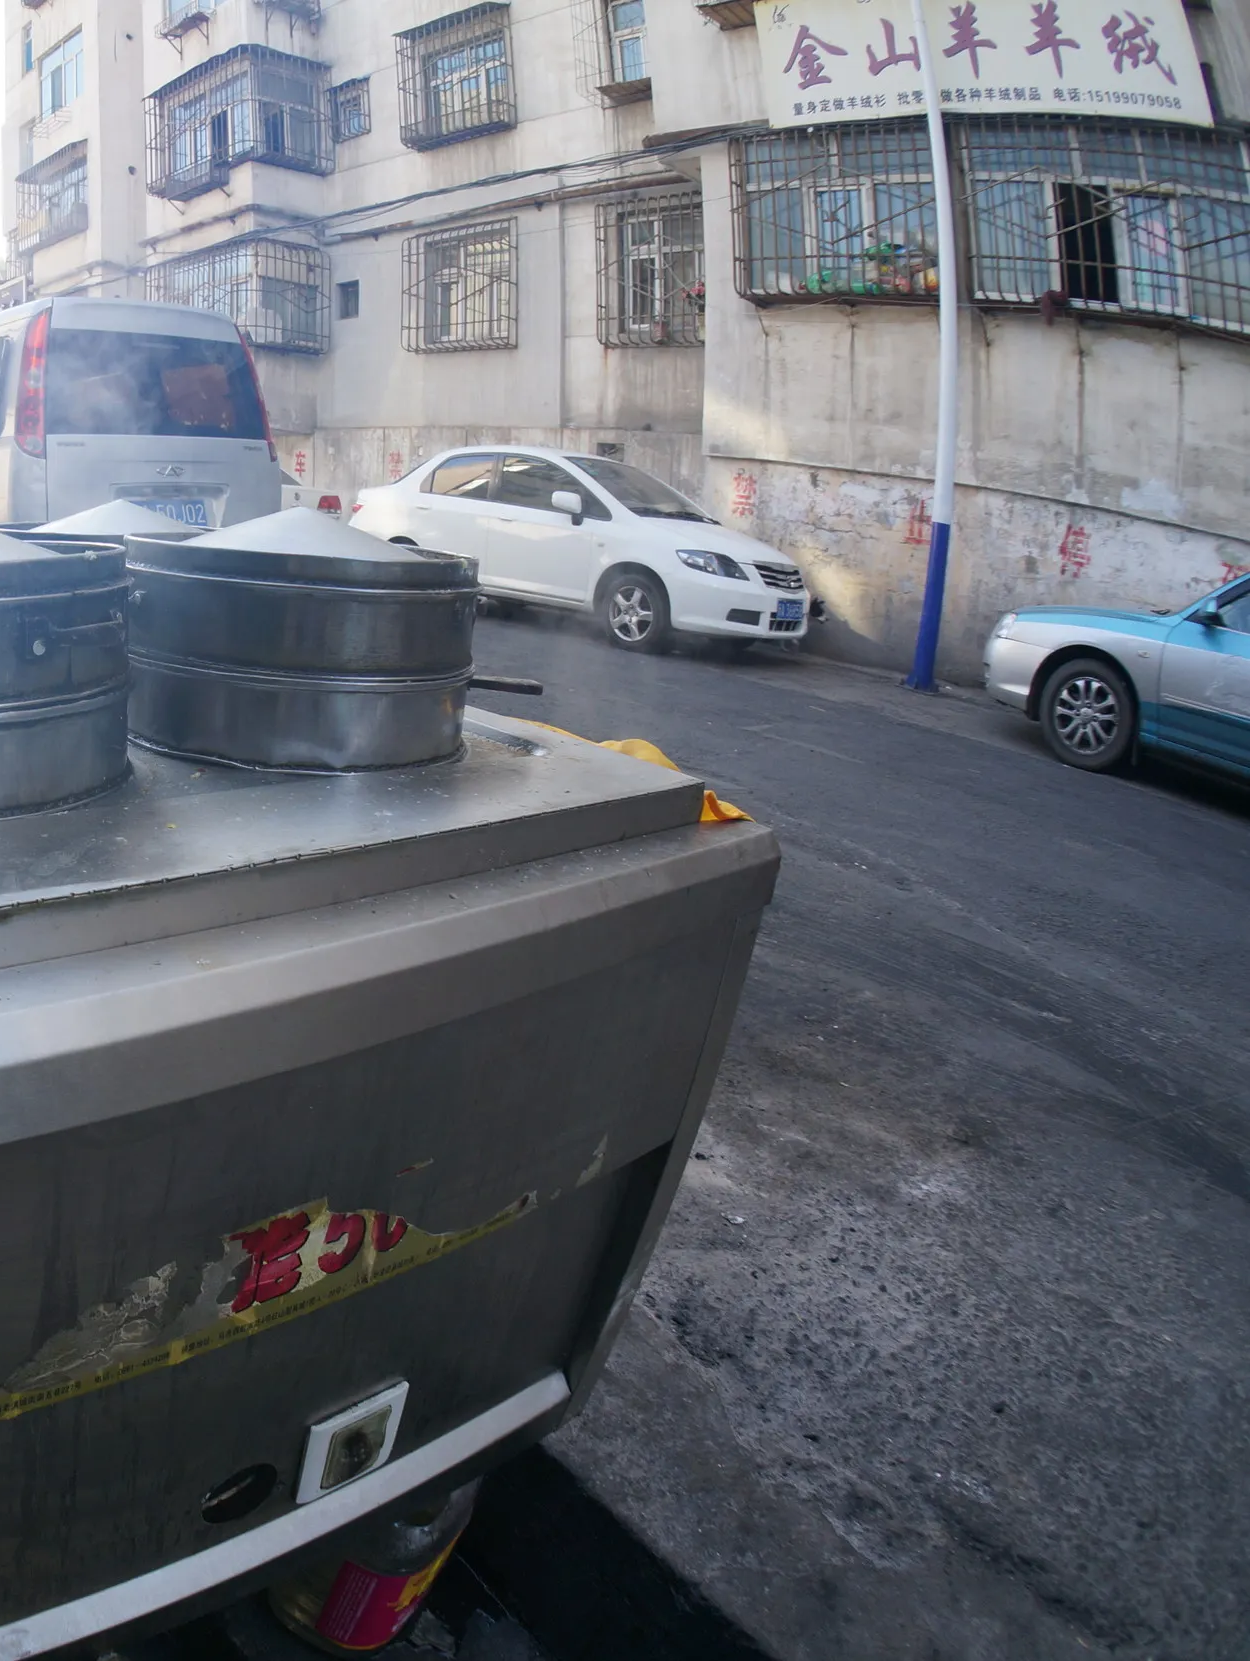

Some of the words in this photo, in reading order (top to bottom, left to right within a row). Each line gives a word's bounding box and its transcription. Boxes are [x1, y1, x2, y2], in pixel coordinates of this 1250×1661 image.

[783, 0, 1177, 90] 金山羊羊绒
[793, 94, 886, 116] 量身定做羊绒衫
[732, 473, 757, 517] 禁
[903, 499, 932, 544] 止
[1059, 524, 1091, 578] 停
